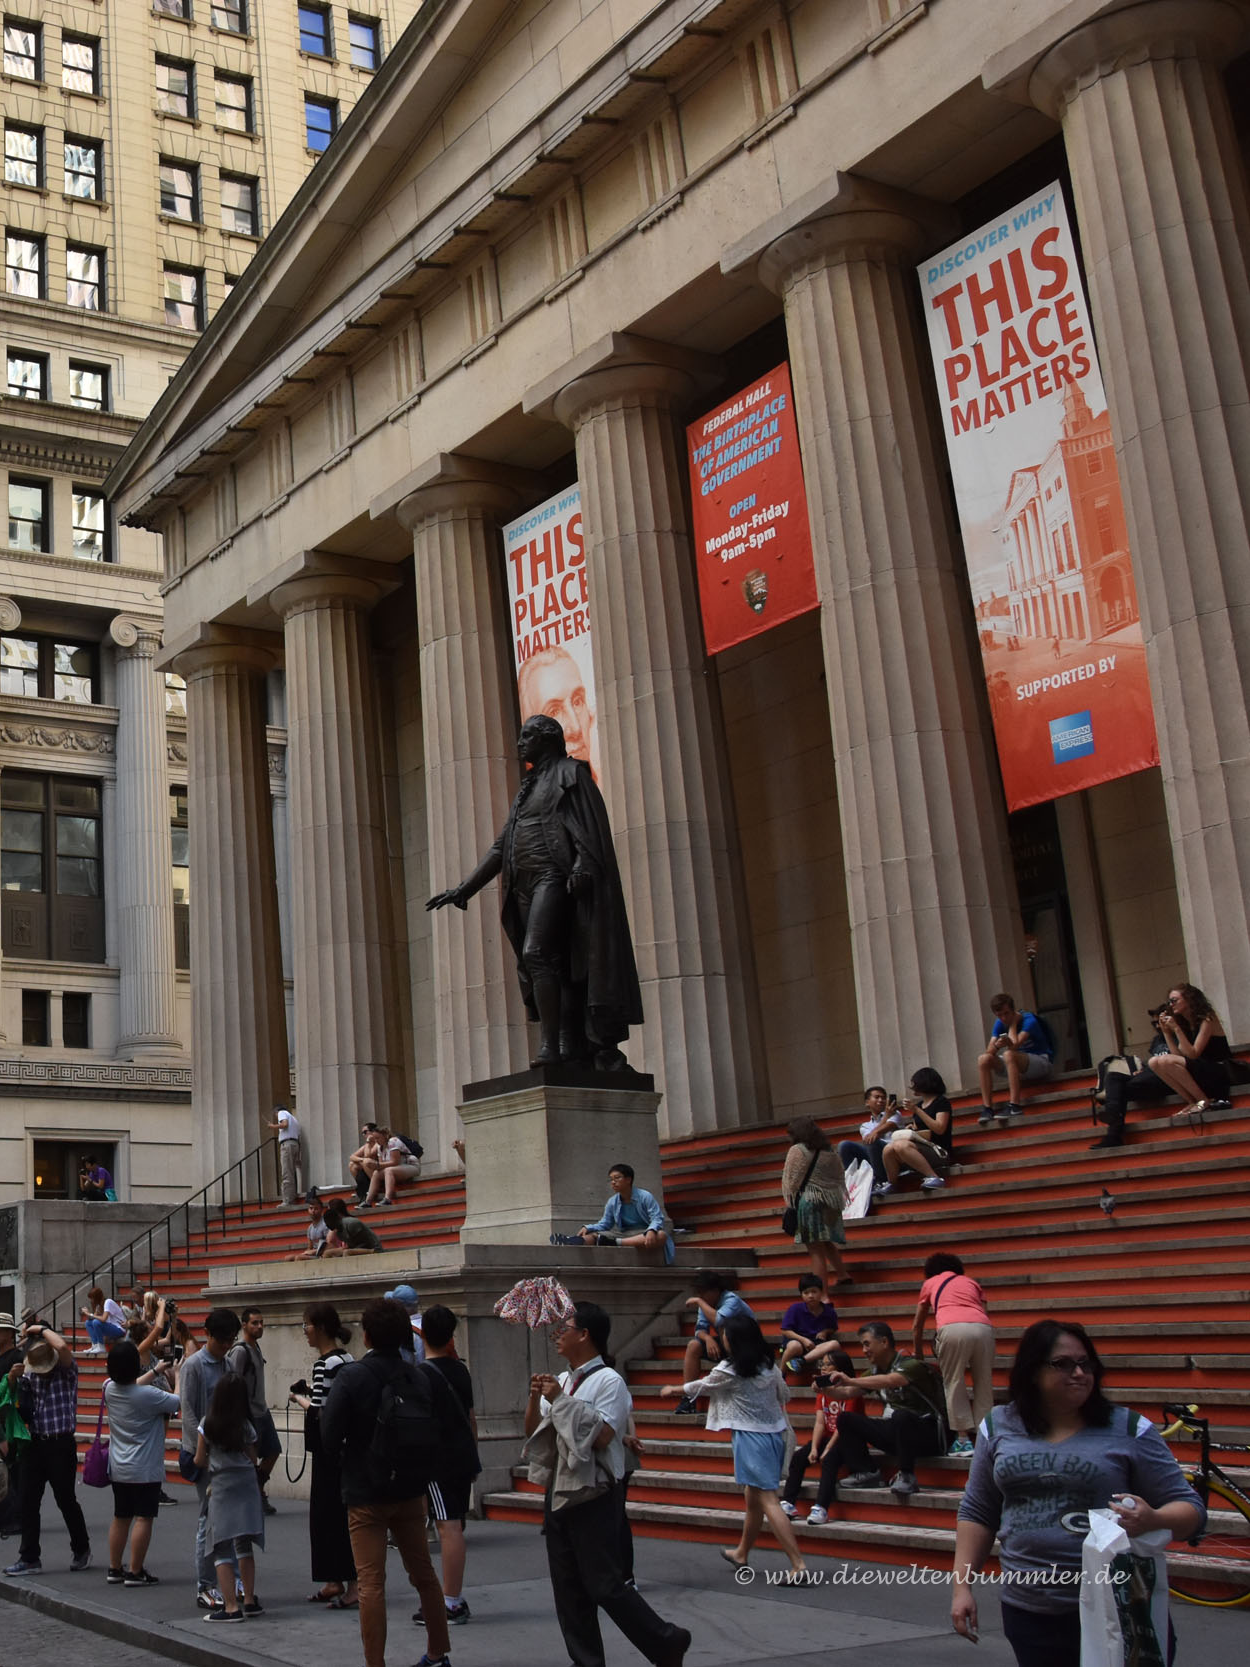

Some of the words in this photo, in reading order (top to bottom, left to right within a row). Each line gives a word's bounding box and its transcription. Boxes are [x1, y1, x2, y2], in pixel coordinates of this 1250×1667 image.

[927, 224, 1010, 284] DISCOVER
[1012, 193, 1056, 233] WHY
[931, 226, 1069, 351] THIS
[943, 291, 1084, 402] PLACE
[702, 398, 745, 436] FEDERAL
[745, 382, 772, 408] HALL
[950, 342, 1091, 437] MATTERS
[692, 437, 713, 465] THE
[713, 393, 787, 452] BIRTHPLACE
[700, 457, 716, 479] OF
[715, 417, 779, 468] AMERICAN
[701, 436, 784, 497] GOVERNMENT
[507, 502, 557, 542] DISCOVER
[705, 500, 790, 554] Monday-Friday
[728, 492, 757, 519] OPEN
[509, 512, 586, 596] THIS
[720, 525, 777, 563] 9am-5pm
[513, 567, 589, 636] PLACE
[1016, 663, 1096, 701] SUPPORTED
[1099, 654, 1117, 674] BY
[1051, 724, 1091, 744] AMERICAN
[1059, 733, 1094, 751] EXPRESS
[995, 1452, 1057, 1479] GREEN
